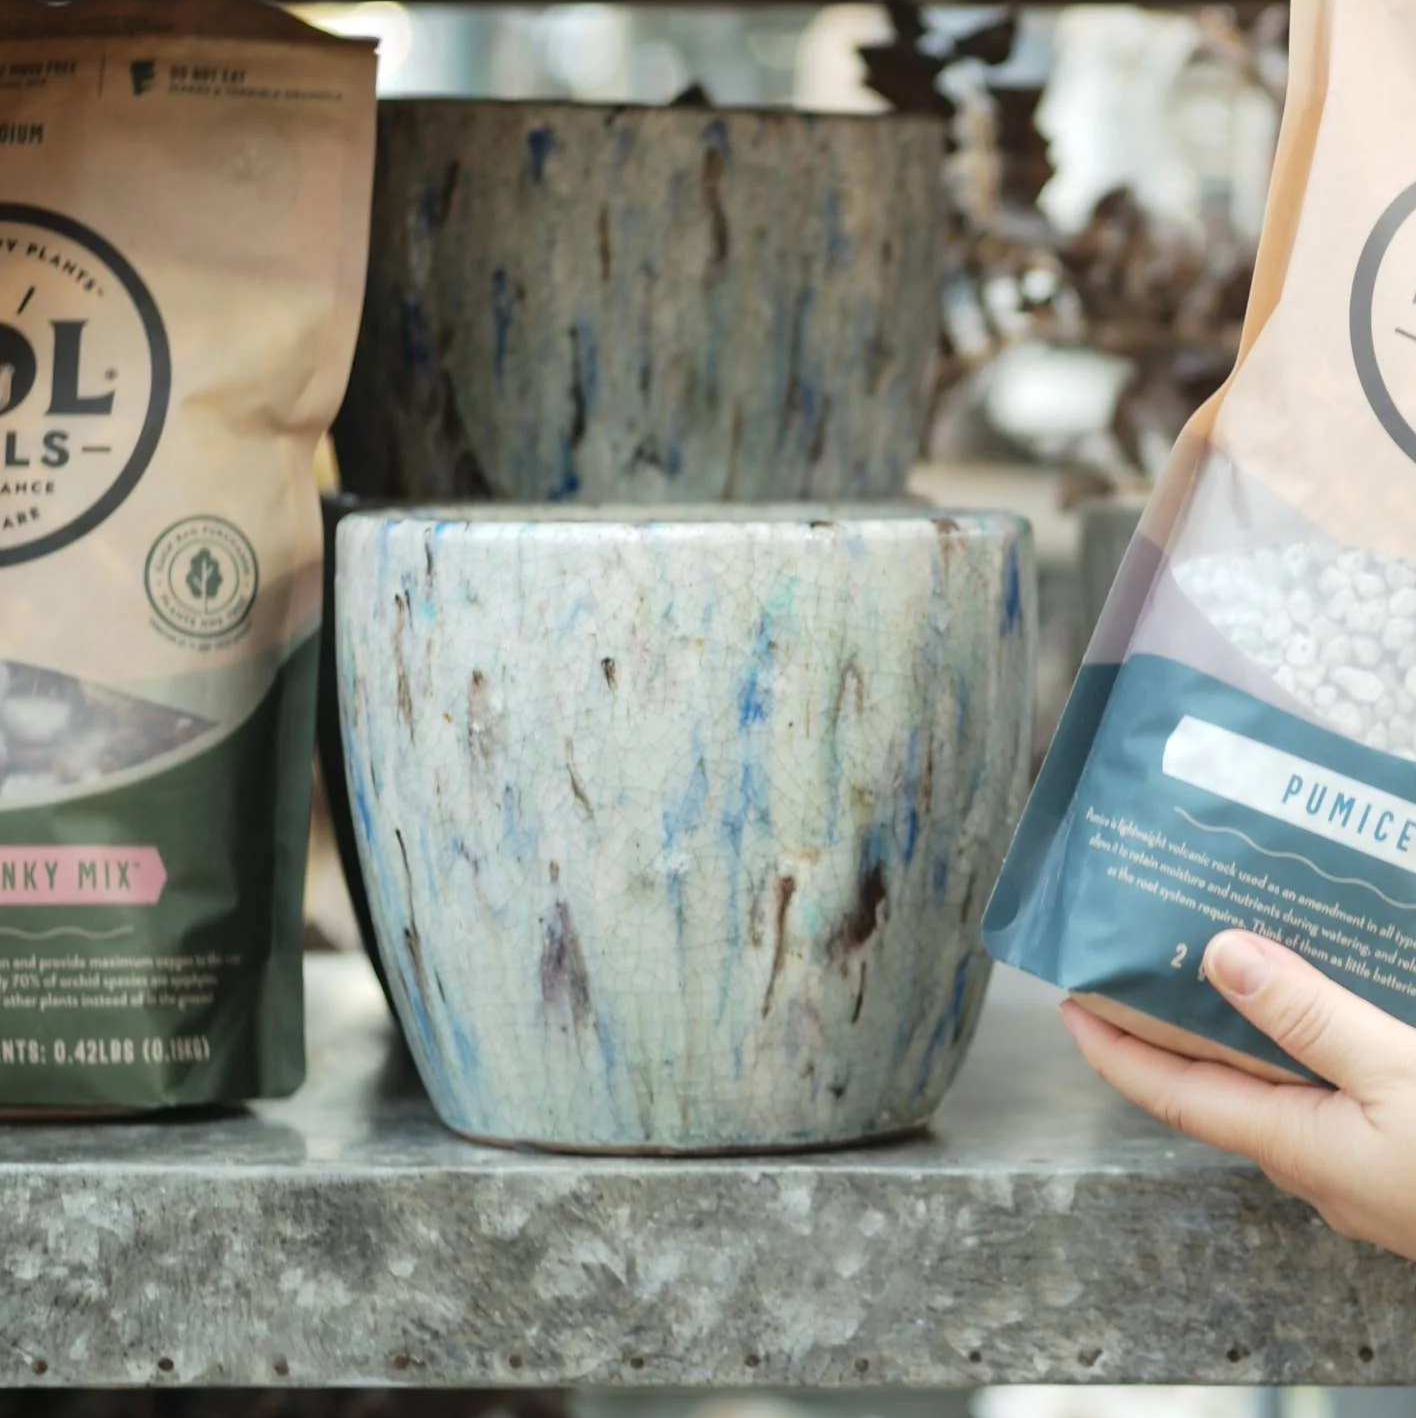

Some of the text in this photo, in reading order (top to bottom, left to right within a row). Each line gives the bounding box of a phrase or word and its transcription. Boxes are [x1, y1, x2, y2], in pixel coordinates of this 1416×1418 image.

[2, 861, 58, 889] NKY
[1119, 819, 1167, 849] lightweight
[1168, 842, 1210, 866] volcanic
[1212, 860, 1236, 877] rock
[1239, 873, 1269, 889] used
[1268, 882, 1280, 896] as
[1282, 889, 1296, 902] an
[1299, 895, 1365, 928] amendment
[1367, 918, 1377, 934] in
[1379, 924, 1395, 941] all
[1118, 866, 1134, 884] the
[1136, 878, 1159, 893] root
[1160, 886, 1196, 909] system
[1198, 902, 1246, 929] requires.
[1285, 934, 1299, 948] of
[1300, 940, 1328, 961] them
[1330, 955, 1343, 968] as
[1345, 956, 1371, 978] little
[1129, 851, 1158, 869] retain
[1160, 862, 1206, 889] moisture
[1207, 884, 1230, 898] and
[1230, 890, 1280, 919] nutrients
[1283, 909, 1318, 936] during
[1322, 926, 1371, 957] watering,
[1375, 948, 1396, 965] and
[1171, 943, 1187, 969] 2
[3, 992, 128, 1012] other plants instead
[54, 1037, 134, 1065] 0.42LBS
